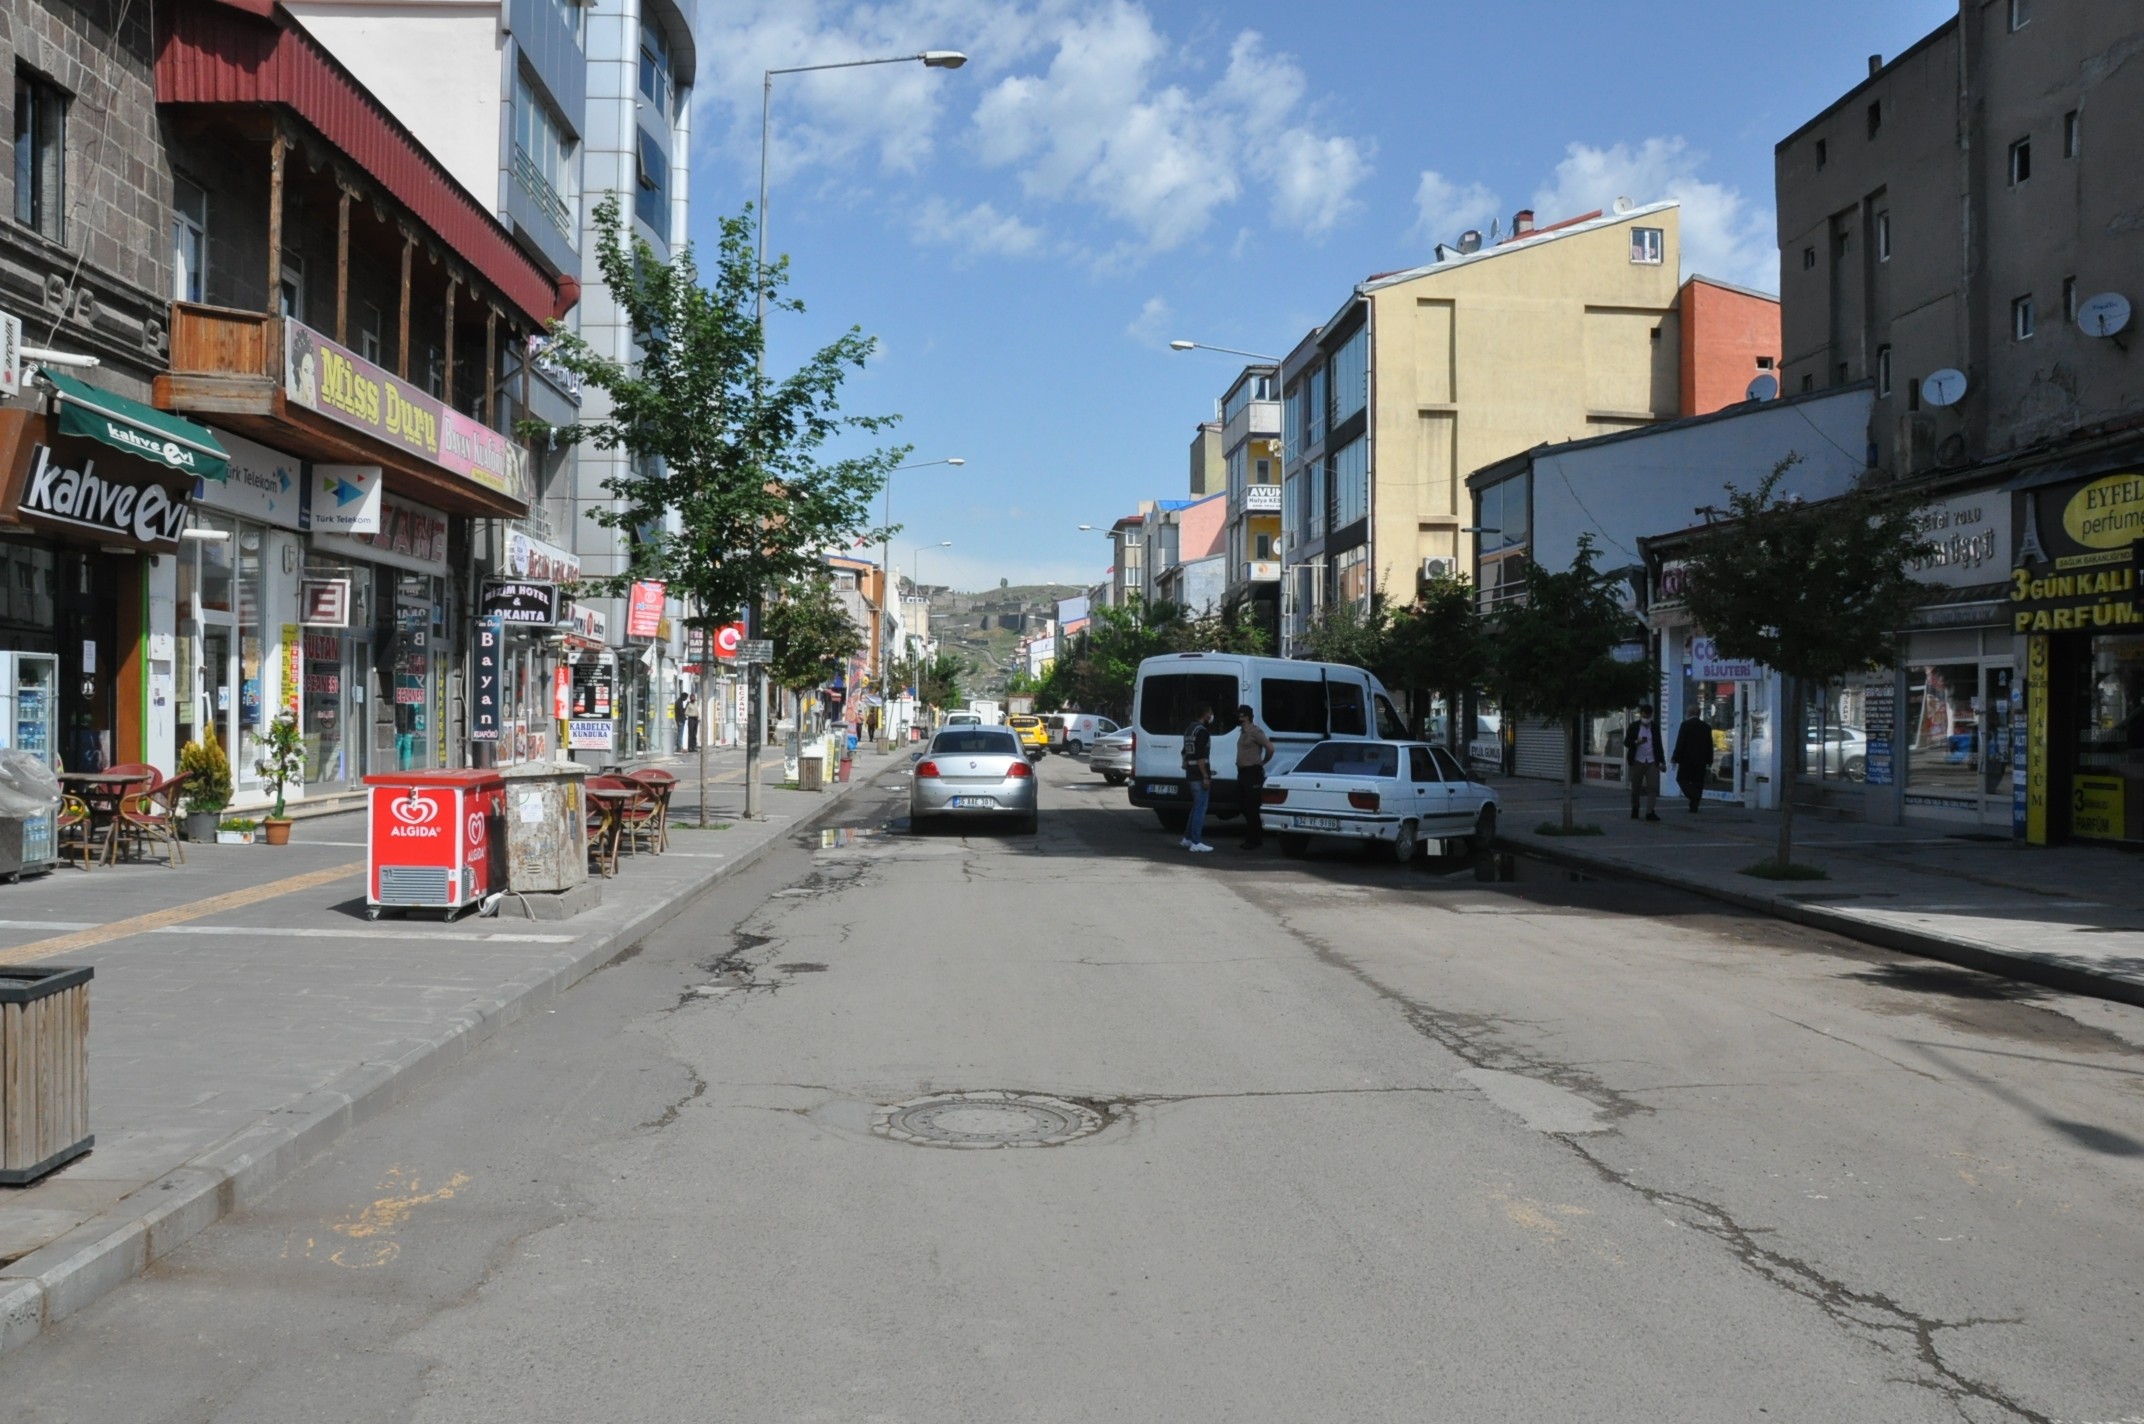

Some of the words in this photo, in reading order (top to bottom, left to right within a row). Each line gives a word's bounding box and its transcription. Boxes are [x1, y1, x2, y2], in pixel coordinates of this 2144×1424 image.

[320, 346, 380, 425] Miss
[385, 381, 437, 453] Duru
[107, 422, 161, 452] kahve
[226, 463, 241, 482] ürk
[243, 468, 277, 494] Telekom
[2086, 480, 2144, 510] EYFEL
[315, 515, 335, 523] Türk
[336, 515, 371, 524] Telekom
[1953, 507, 1981, 526] YOLU
[518, 585, 549, 605] HOTEL
[2009, 568, 2031, 601] 3
[2030, 572, 2075, 599] GÜN
[513, 597, 521, 606] &
[569, 722, 611, 731] KARDELEN
